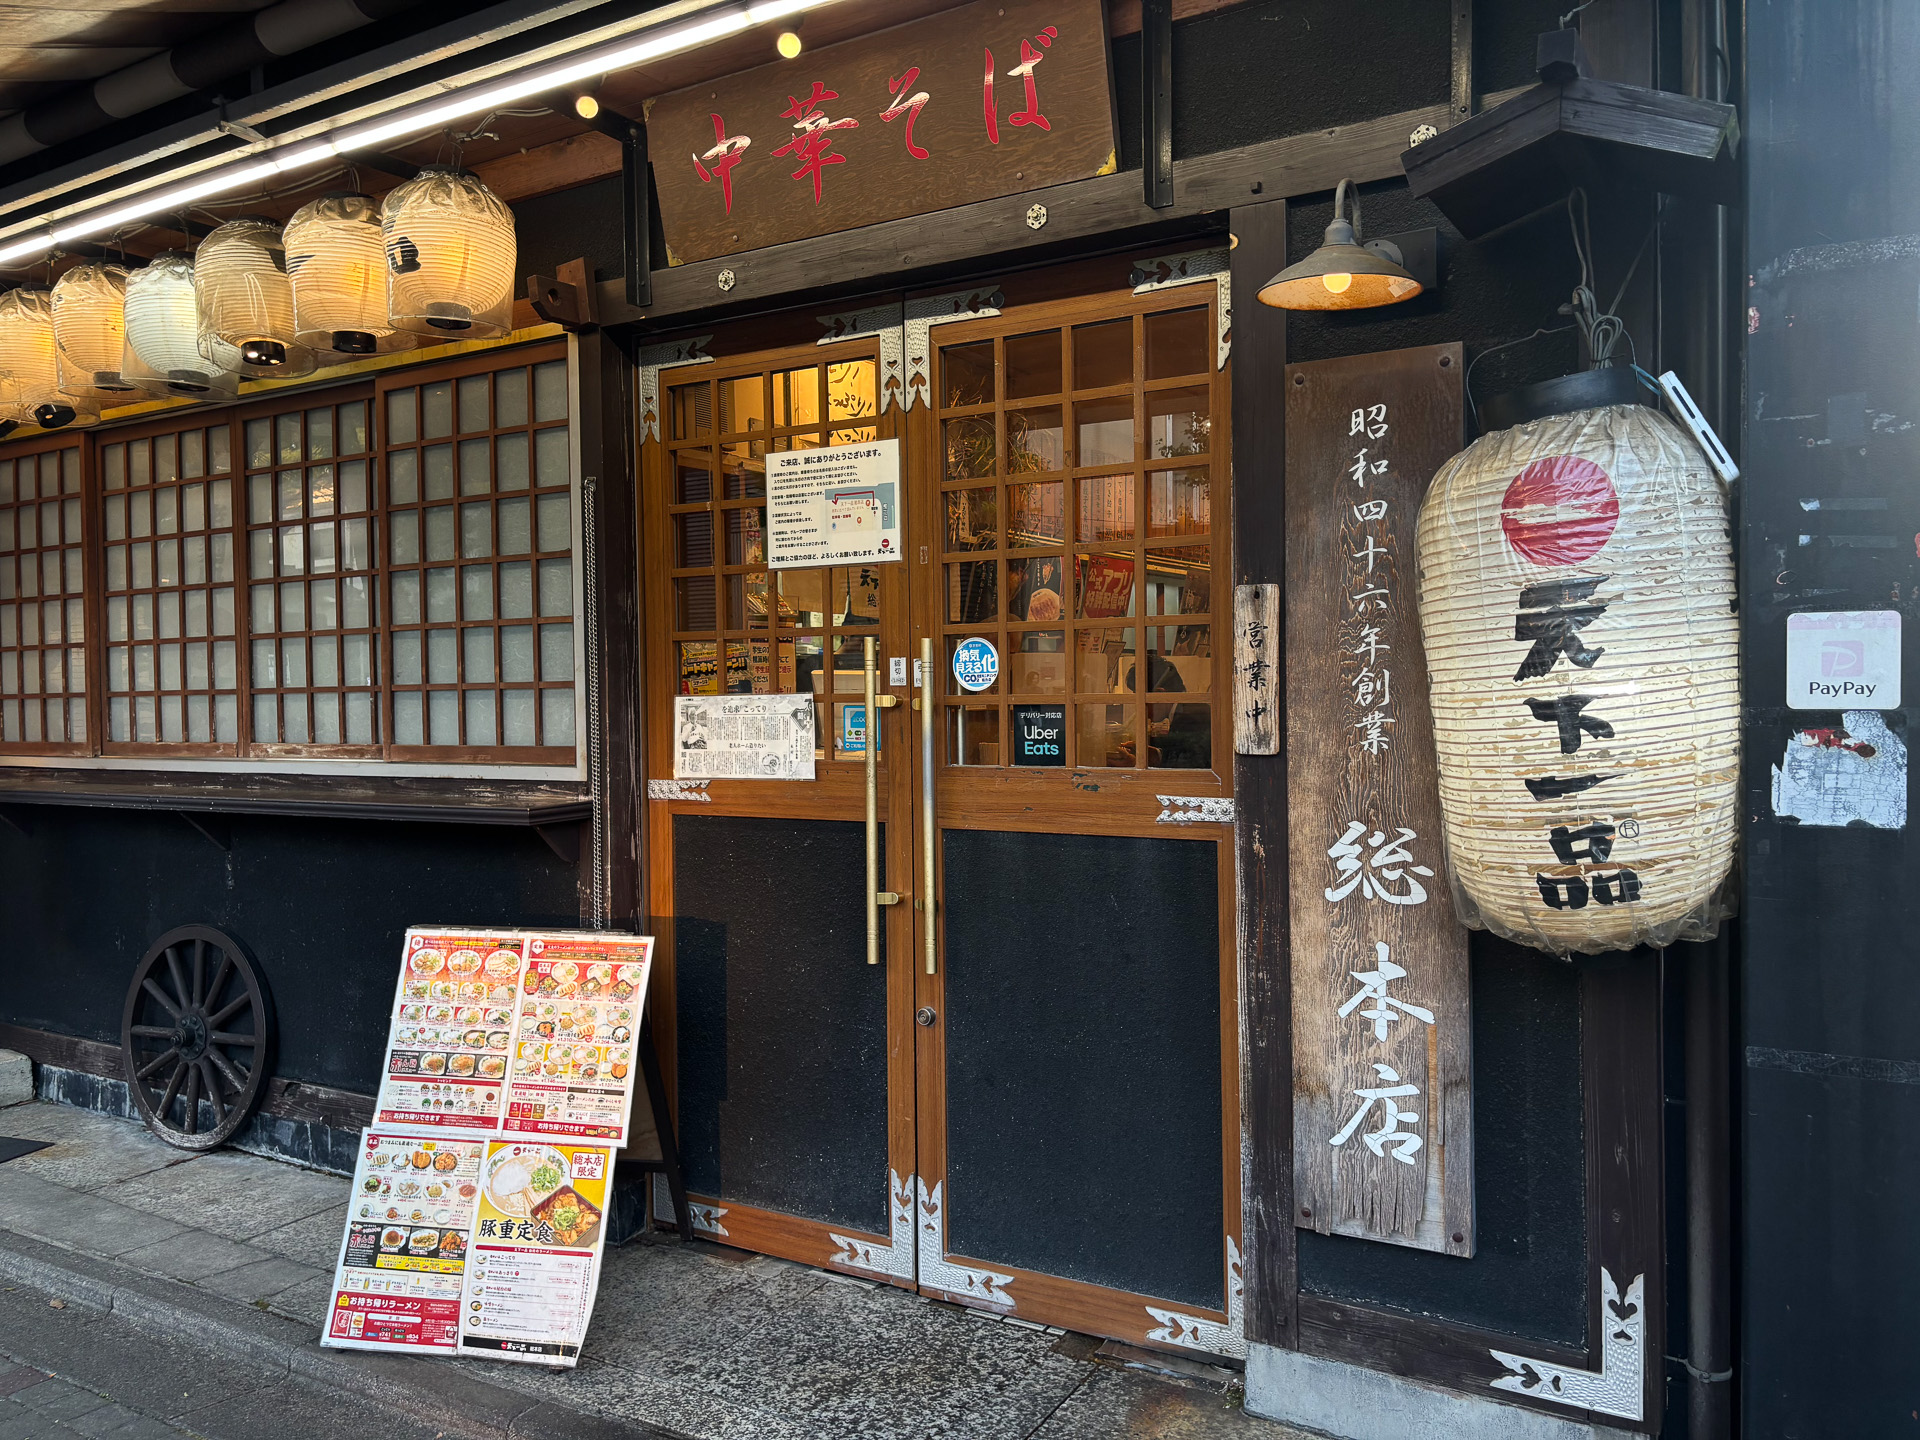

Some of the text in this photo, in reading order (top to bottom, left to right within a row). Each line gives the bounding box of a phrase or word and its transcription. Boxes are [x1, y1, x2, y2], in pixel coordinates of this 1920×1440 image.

[692, 26, 1058, 216] 中華そば
[780, 448, 881, 467] ご来店、誠にありがとうございます。
[771, 550, 875, 563] ご理解とご協力のほど、よろしくお願い致します。
[1088, 567, 1135, 594] 公式アプリ
[1348, 403, 1395, 756] 昭和四十六年創業
[959, 649, 980, 662] 換気
[956, 654, 997, 673] 見える化
[1242, 620, 1271, 732] 営業中
[1809, 681, 1877, 697] PayPay
[1020, 712, 1062, 720] デリバリー対応店
[1024, 726, 1059, 740] Uber
[1024, 742, 1060, 756] Eats
[1513, 574, 1643, 910] 天下一品
[1324, 818, 1435, 1167] 総本店
[393, 1112, 440, 1122] お持ち帰りできます
[537, 1123, 585, 1133] お持ち帰りできます
[573, 1154, 603, 1166] 総本店
[577, 1166, 597, 1177] 限定
[479, 1219, 555, 1243] 豚重定食
[349, 1296, 421, 1309] お持ち帰りラーメン
